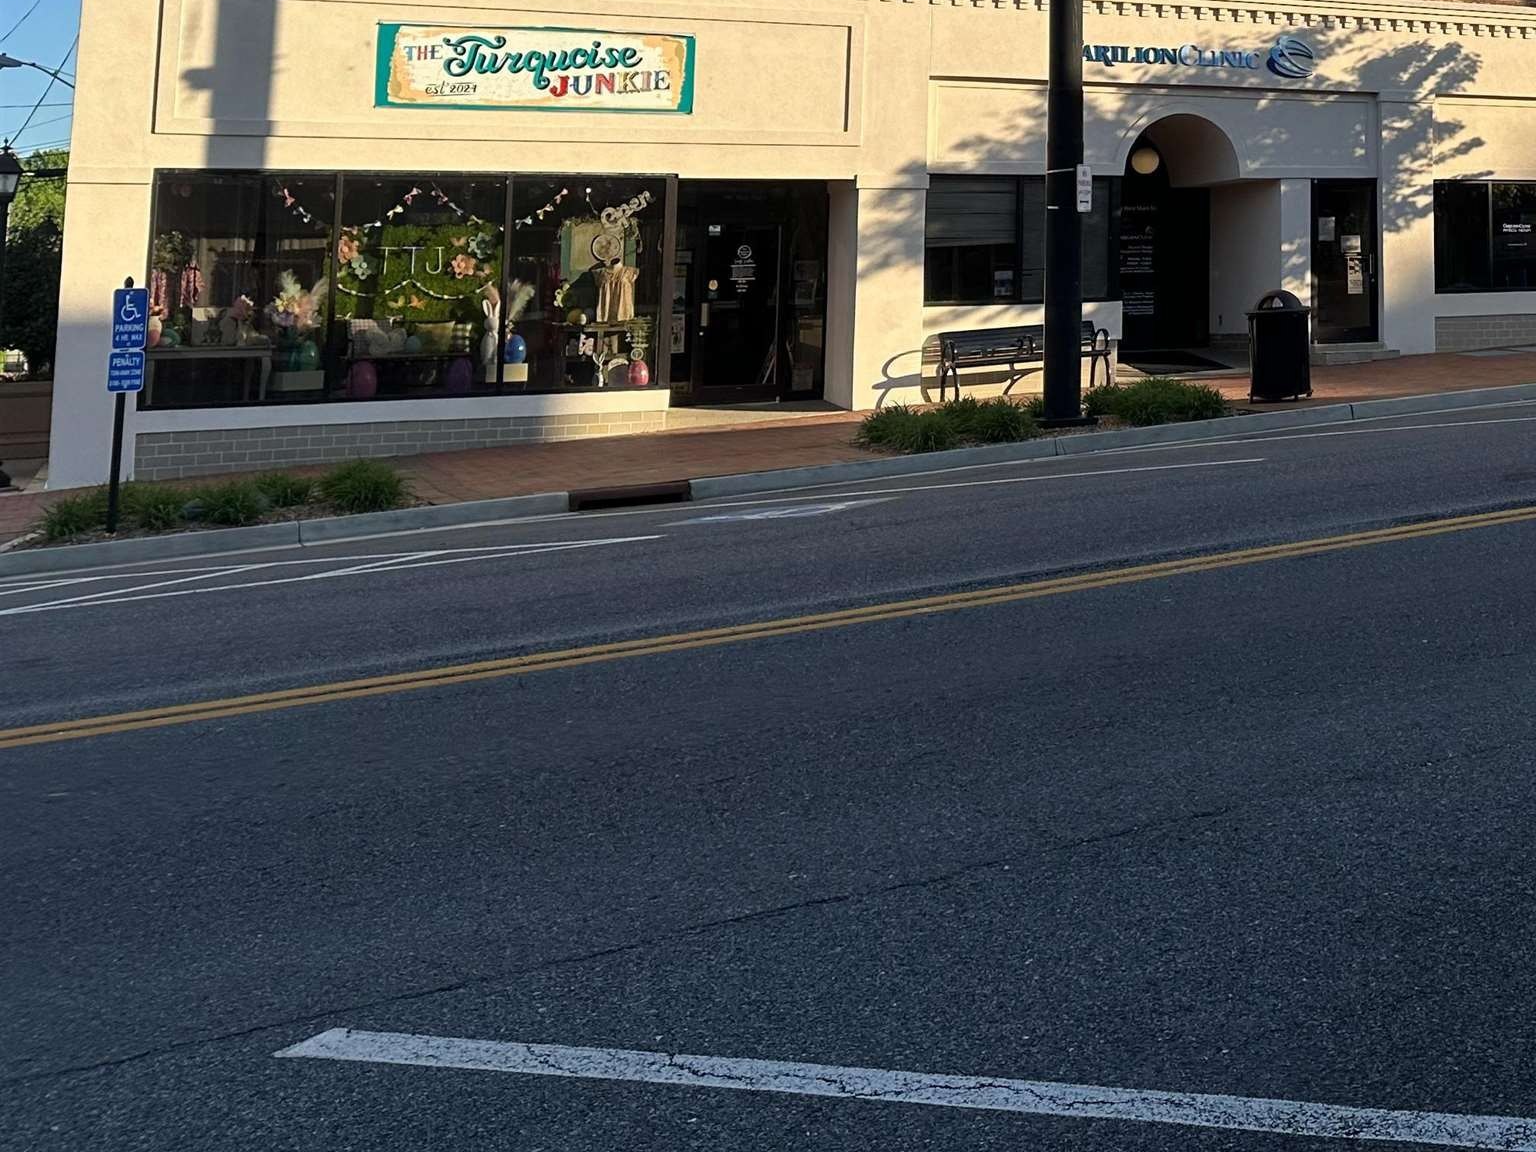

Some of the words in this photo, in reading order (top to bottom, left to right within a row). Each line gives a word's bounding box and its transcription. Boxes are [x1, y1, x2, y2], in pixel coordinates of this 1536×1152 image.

[404, 43, 443, 62] THE
[443, 35, 643, 90] Turquoise
[1082, 44, 1260, 69] ARILIONCLINIC
[549, 69, 672, 97] JUNKIE
[601, 190, 656, 229] Open
[376, 246, 445, 275] TTJ
[114, 323, 144, 333] PARKING
[115, 334, 120, 342] 4
[112, 357, 141, 367] PENALTY
